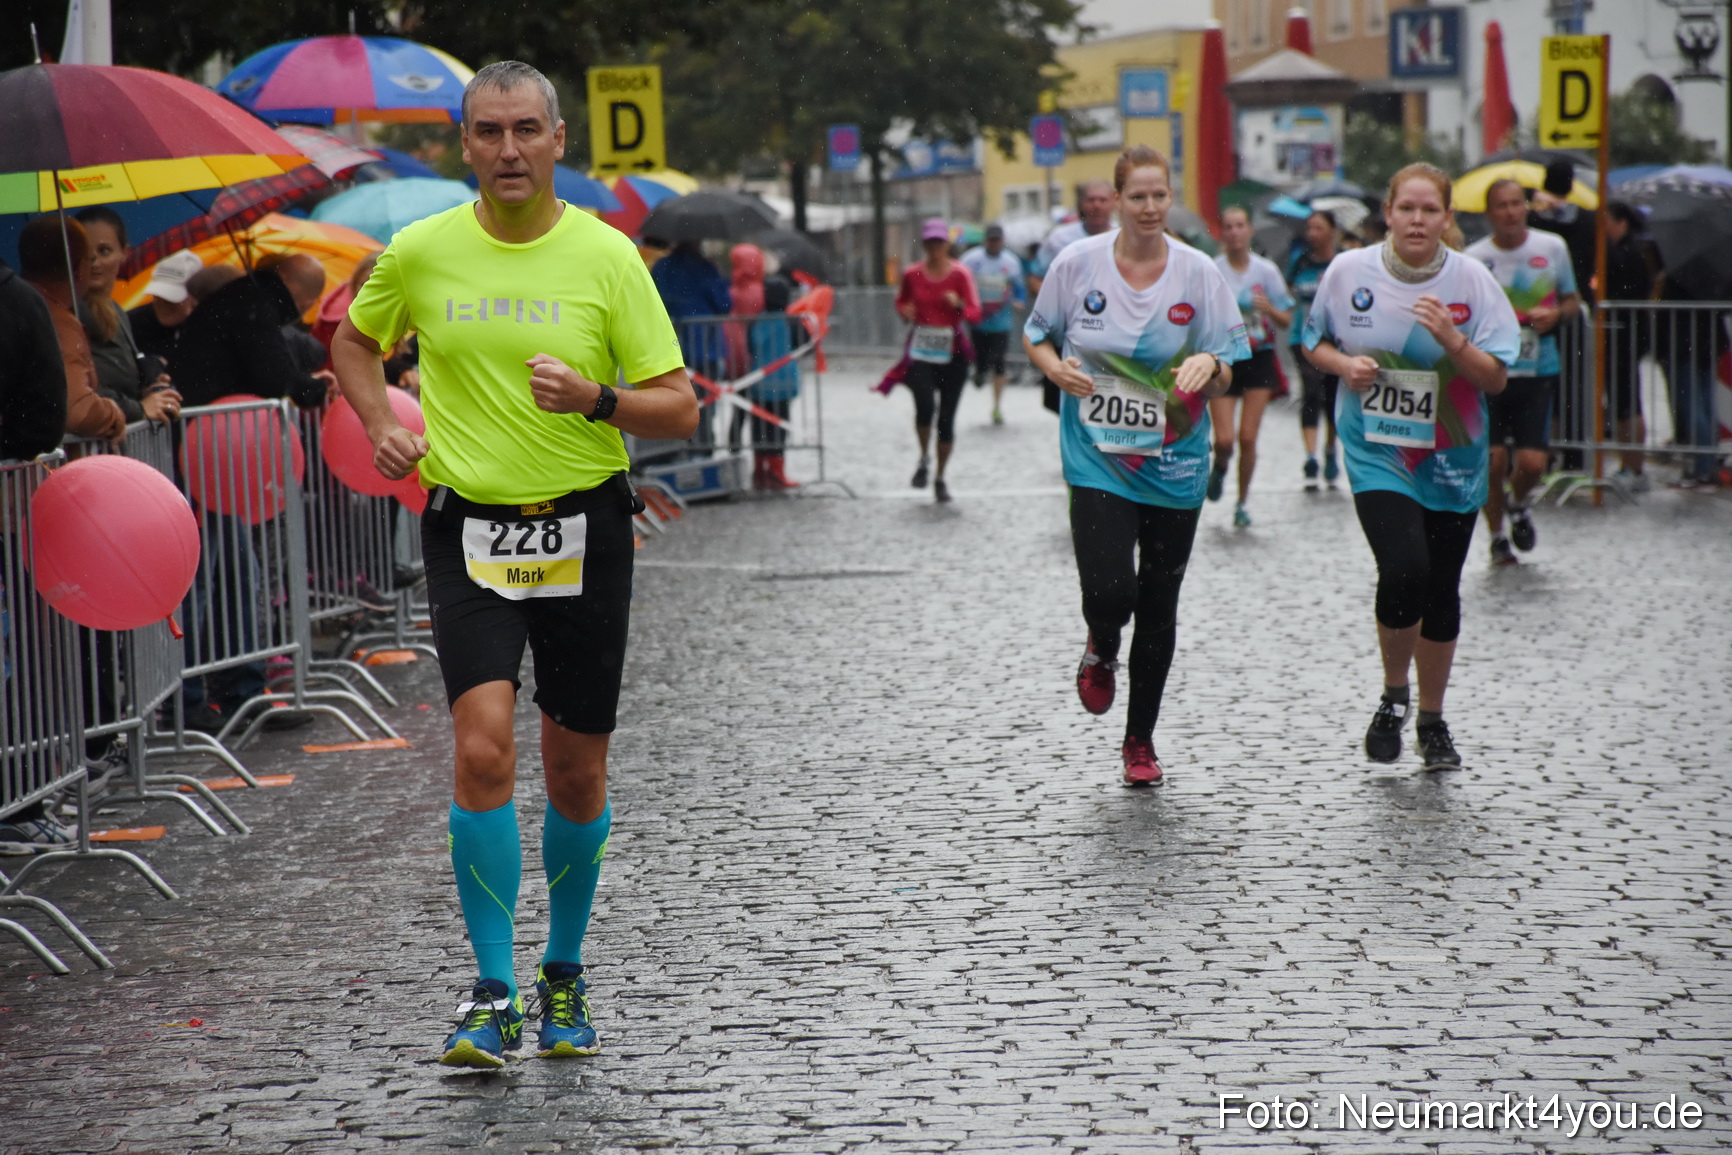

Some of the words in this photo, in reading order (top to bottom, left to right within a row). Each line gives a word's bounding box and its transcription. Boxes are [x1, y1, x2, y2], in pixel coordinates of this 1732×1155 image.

[1549, 39, 1603, 61] Block
[597, 71, 652, 92] Block
[1559, 69, 1591, 121] D
[610, 101, 645, 152] D
[446, 297, 560, 325] RUN
[1088, 394, 1158, 428] 2055
[1363, 383, 1433, 419] 2054
[1104, 432, 1136, 445] Ingrid
[1377, 421, 1411, 435] Agnes
[489, 519, 563, 556] 228
[506, 566, 545, 584] Mark
